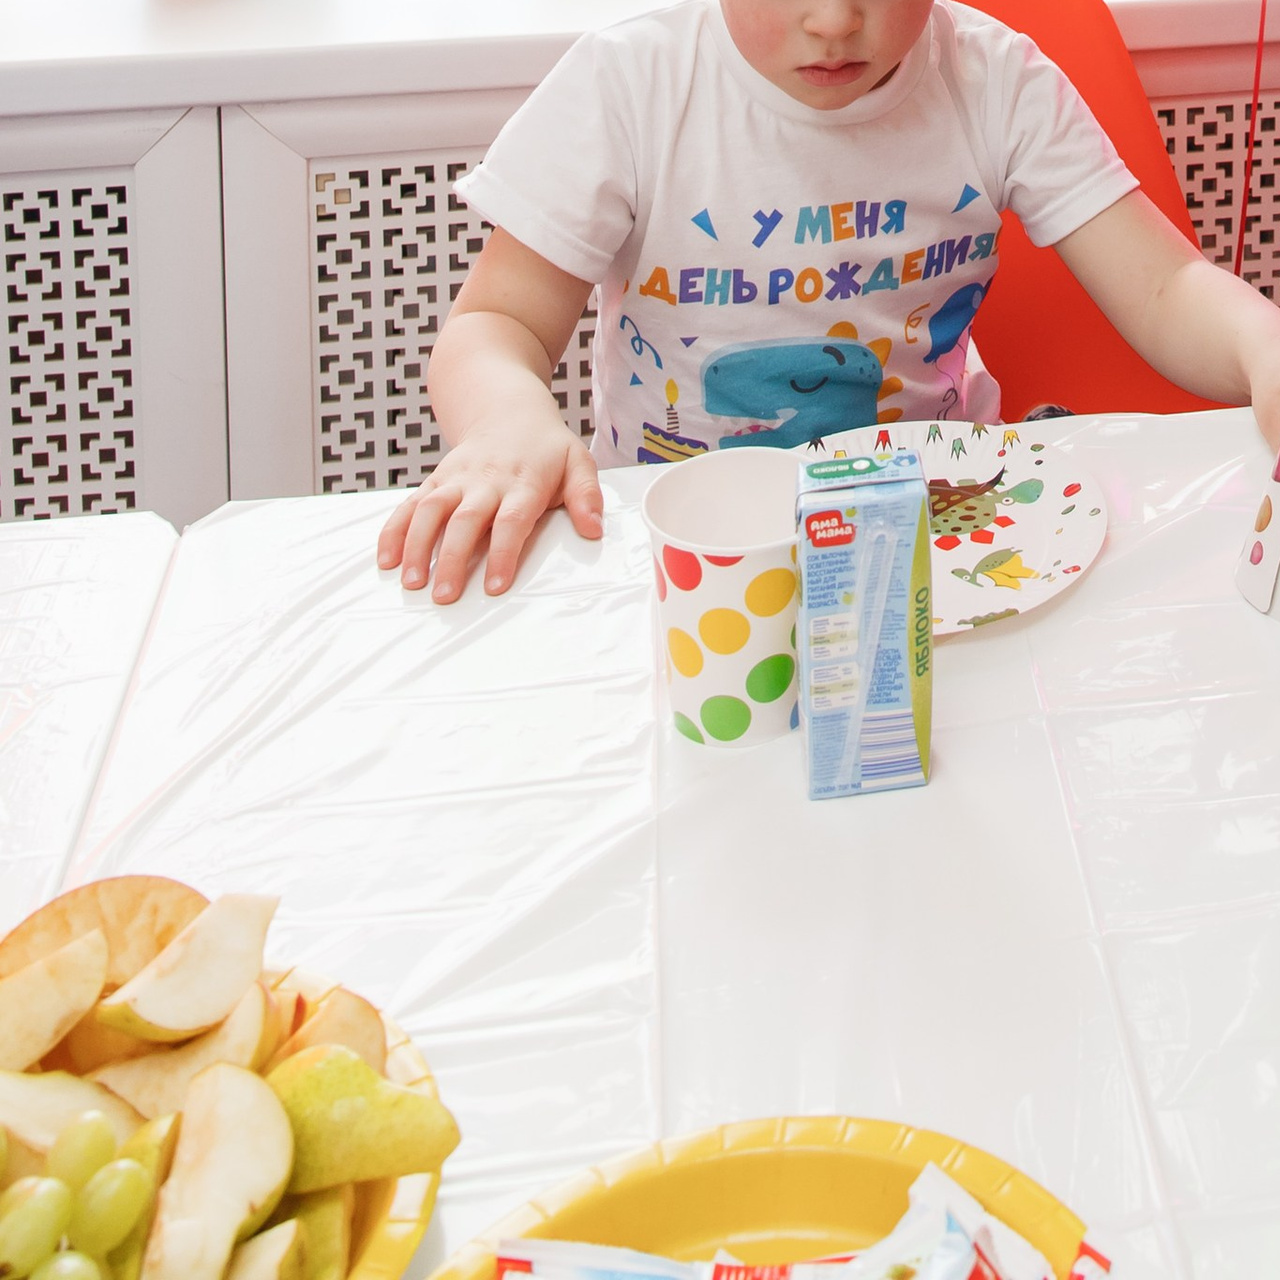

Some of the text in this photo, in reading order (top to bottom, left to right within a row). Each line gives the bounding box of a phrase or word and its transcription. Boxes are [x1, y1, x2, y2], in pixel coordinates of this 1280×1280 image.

[752, 200, 908, 248] У МЕНЯ
[639, 266, 758, 306] ДЕНЬ
[915, 586, 930, 678] ЯБЛОКО
